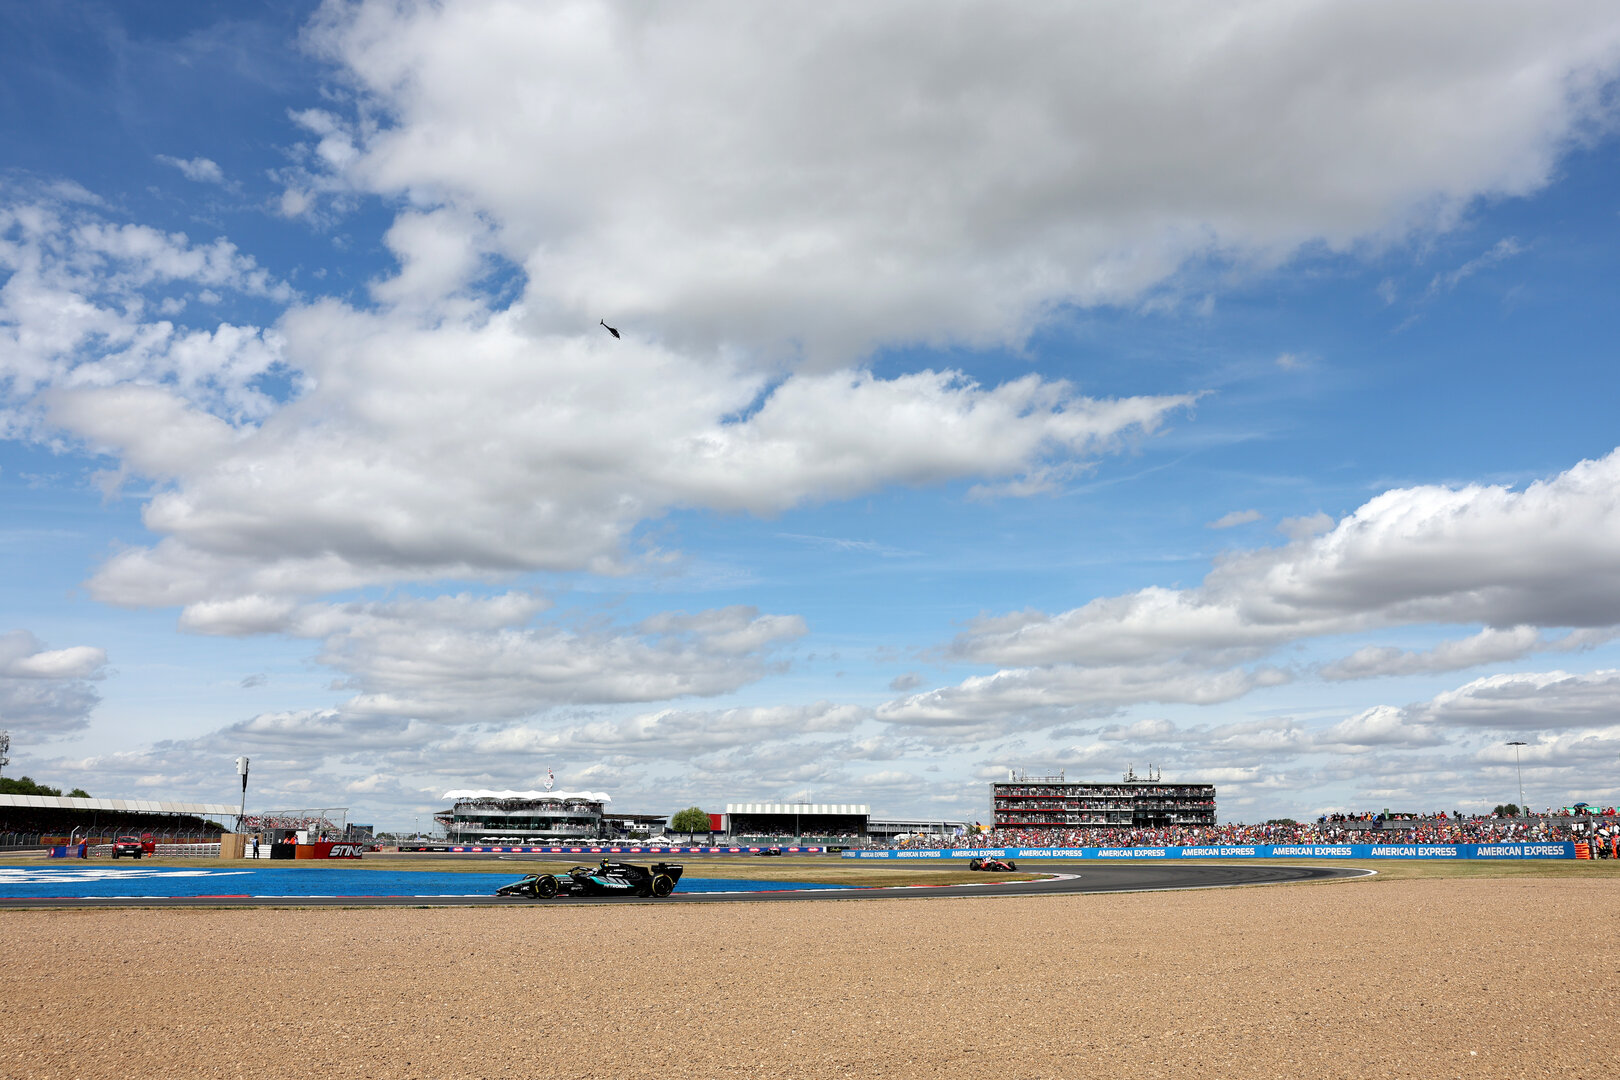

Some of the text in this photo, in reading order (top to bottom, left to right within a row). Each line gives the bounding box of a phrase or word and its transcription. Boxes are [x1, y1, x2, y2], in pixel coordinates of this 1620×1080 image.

[1182, 847, 1255, 856] AMERICAN EXPRESS
[1272, 847, 1352, 855] AMERICAN EXPRESS
[1371, 847, 1457, 856] AMERICAN EXPRESS
[1477, 845, 1564, 856] AMERICAN EXPRESS
